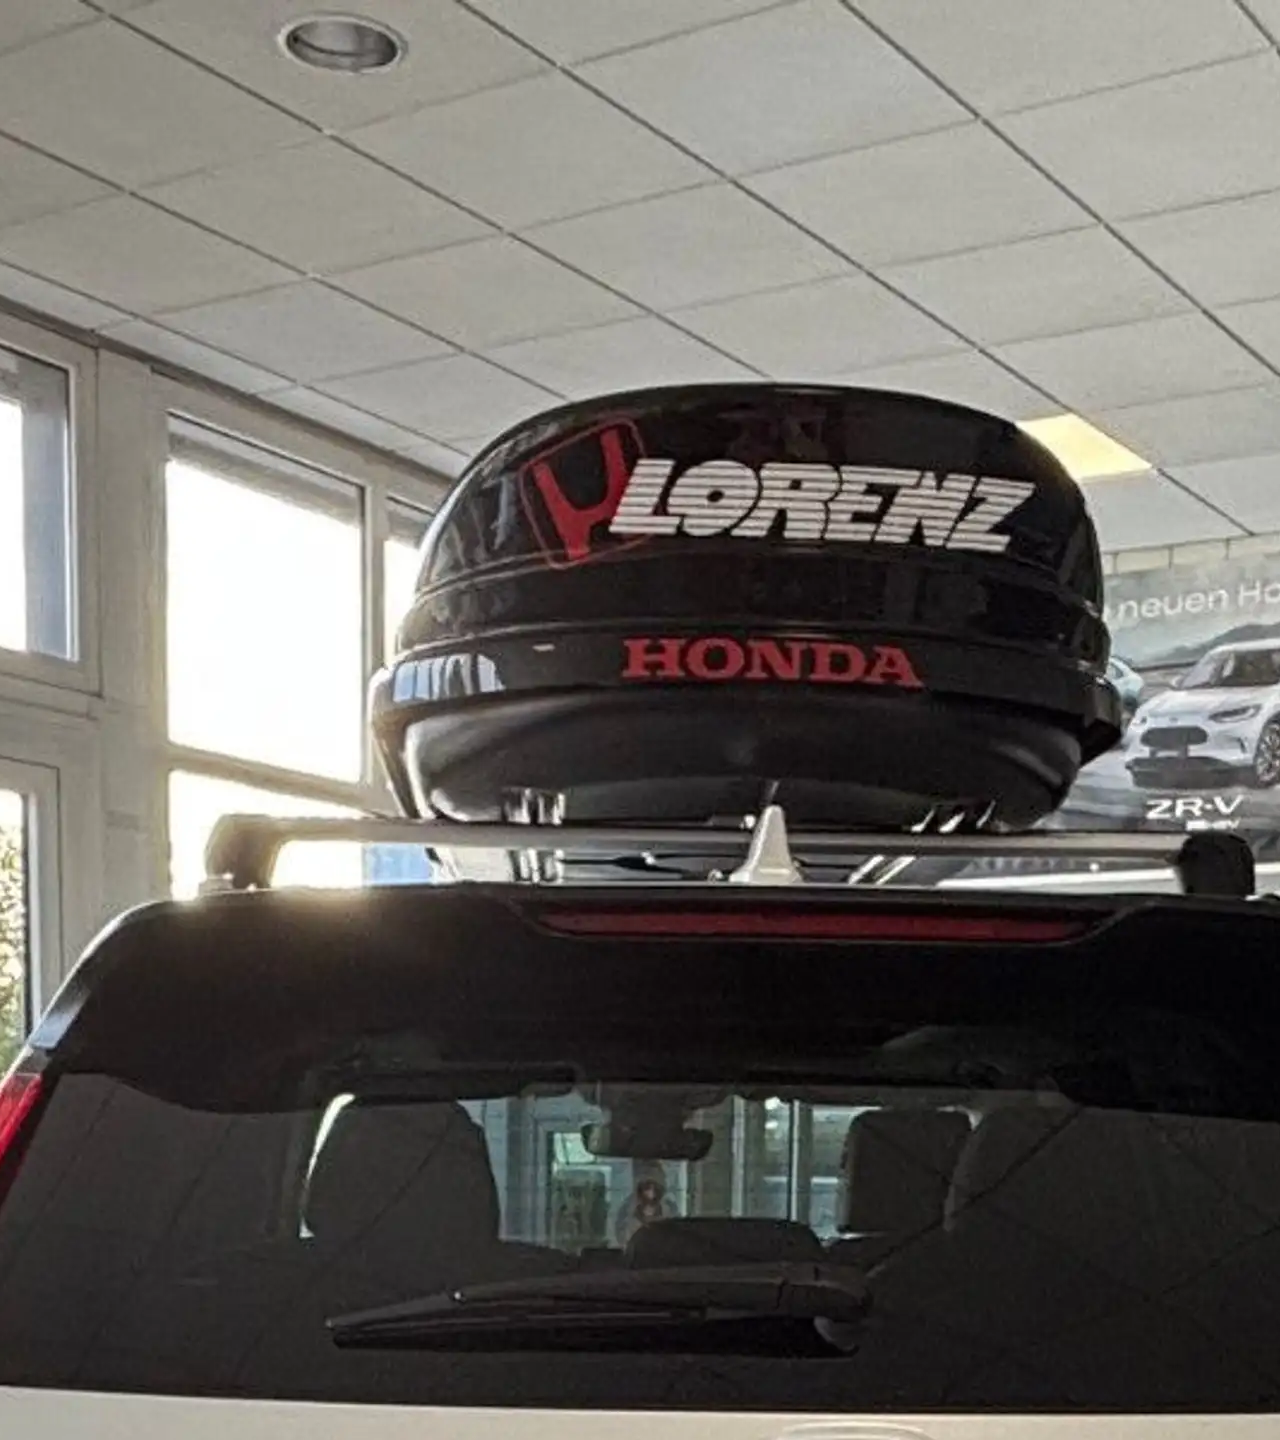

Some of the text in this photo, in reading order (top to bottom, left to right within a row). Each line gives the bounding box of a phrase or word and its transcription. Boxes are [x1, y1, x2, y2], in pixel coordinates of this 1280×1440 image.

[609, 457, 1036, 553] LORENZ
[1119, 585, 1228, 619] neuen
[621, 637, 923, 689] HONDA
[1145, 794, 1244, 820] ZR-V
